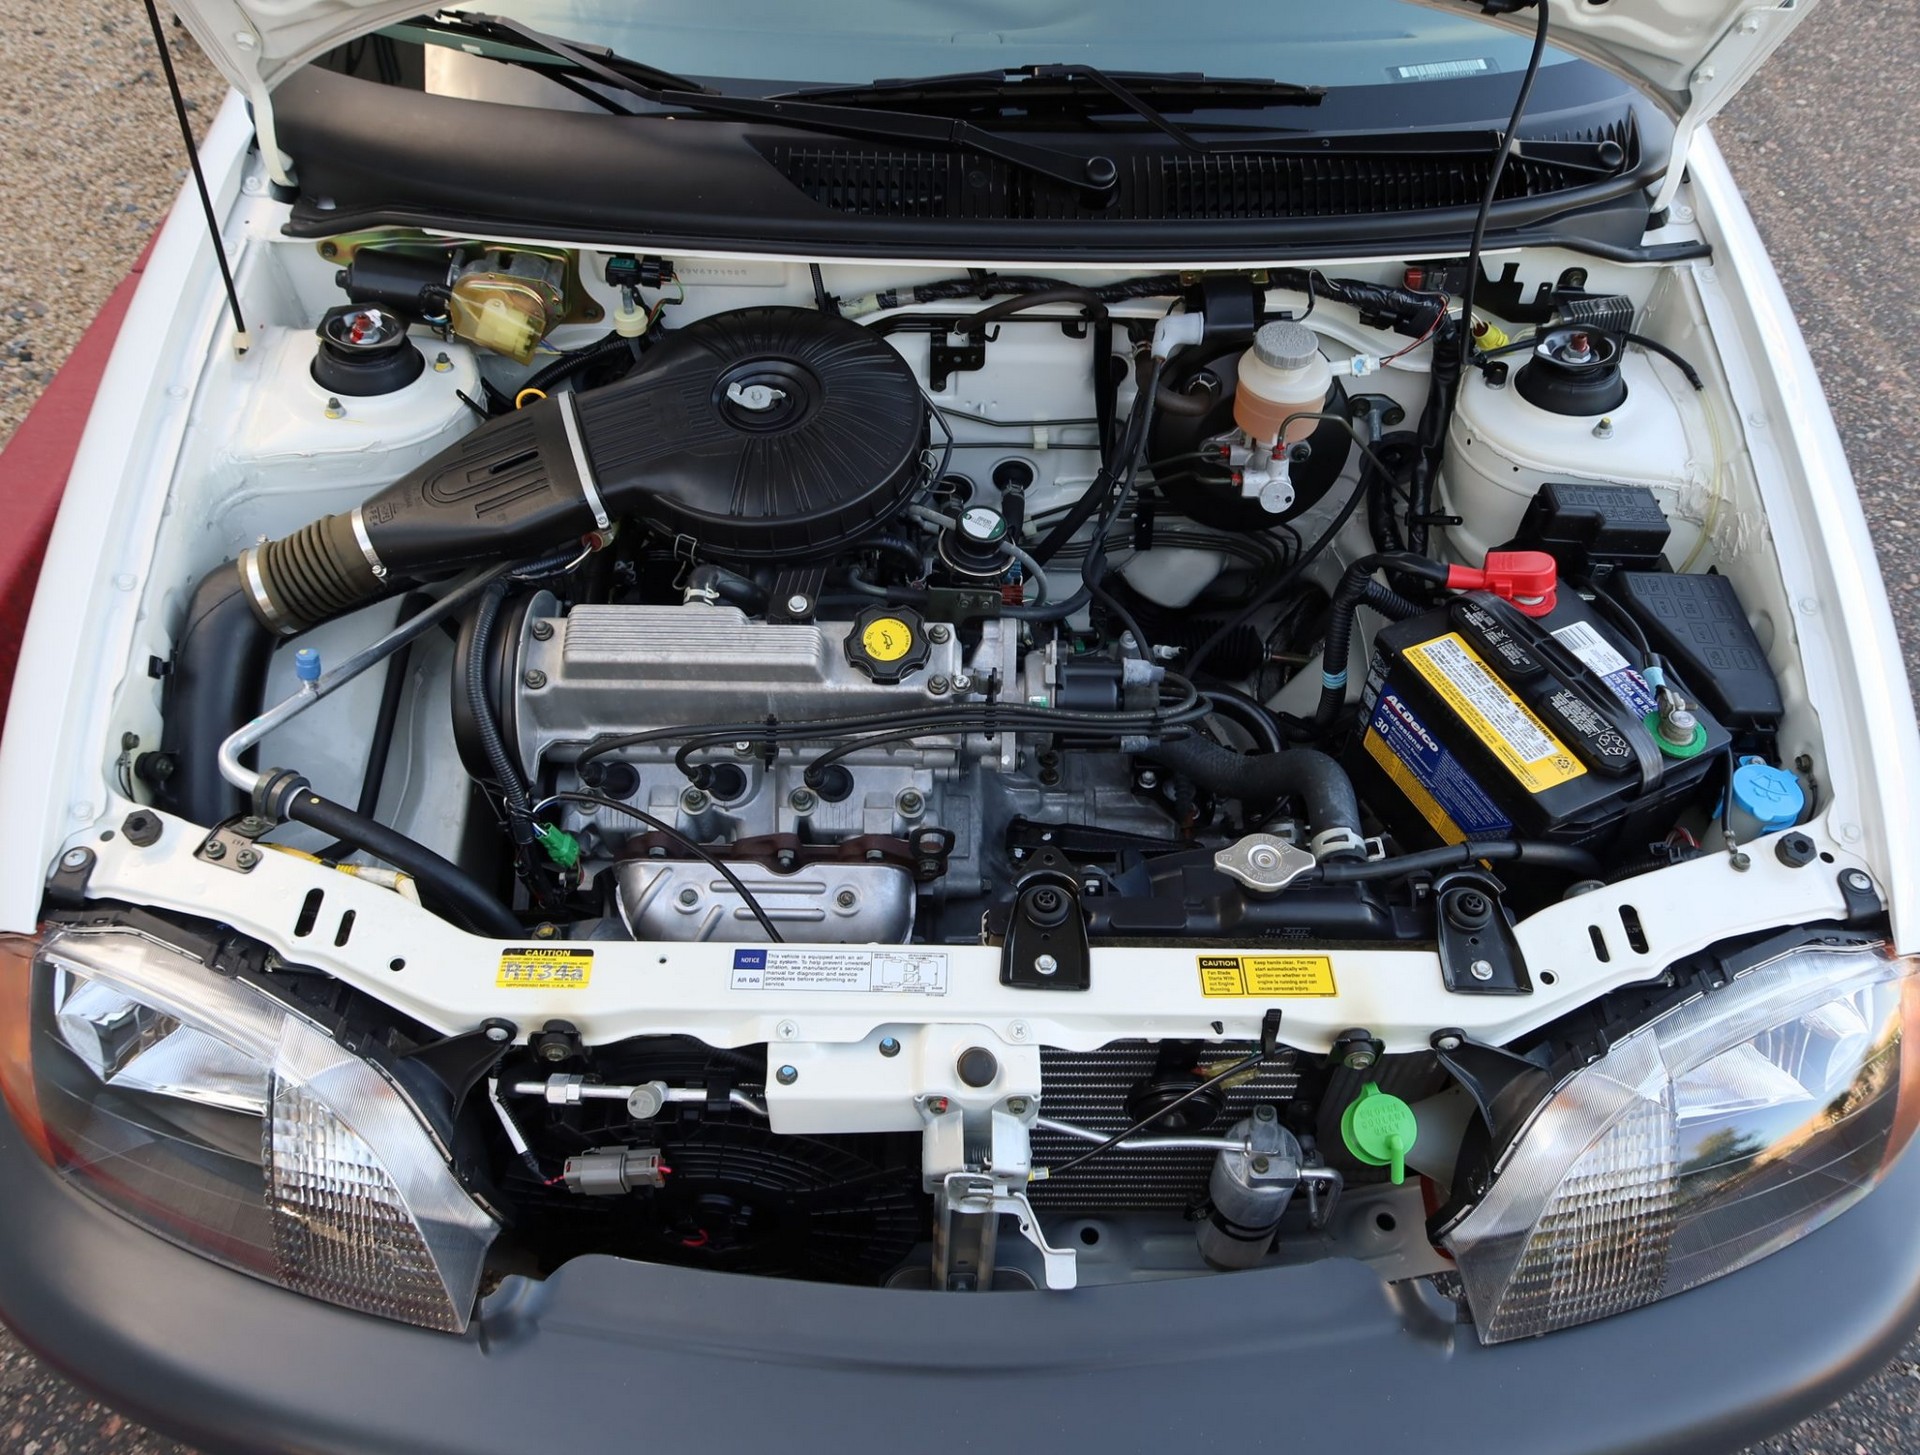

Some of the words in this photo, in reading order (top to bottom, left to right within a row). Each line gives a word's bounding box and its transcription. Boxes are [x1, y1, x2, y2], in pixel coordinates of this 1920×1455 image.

[1620, 683, 1635, 696] CCA
[1374, 716, 1390, 734] 30
[1382, 703, 1424, 751] Professional
[1385, 695, 1439, 752] ACDelco
[525, 949, 571, 957] CAUTION
[504, 962, 583, 980] R134a
[1360, 1103, 1398, 1119] ENGINE
[1361, 1111, 1406, 1129] COOLANT
[1373, 1122, 1399, 1136] ONLY
